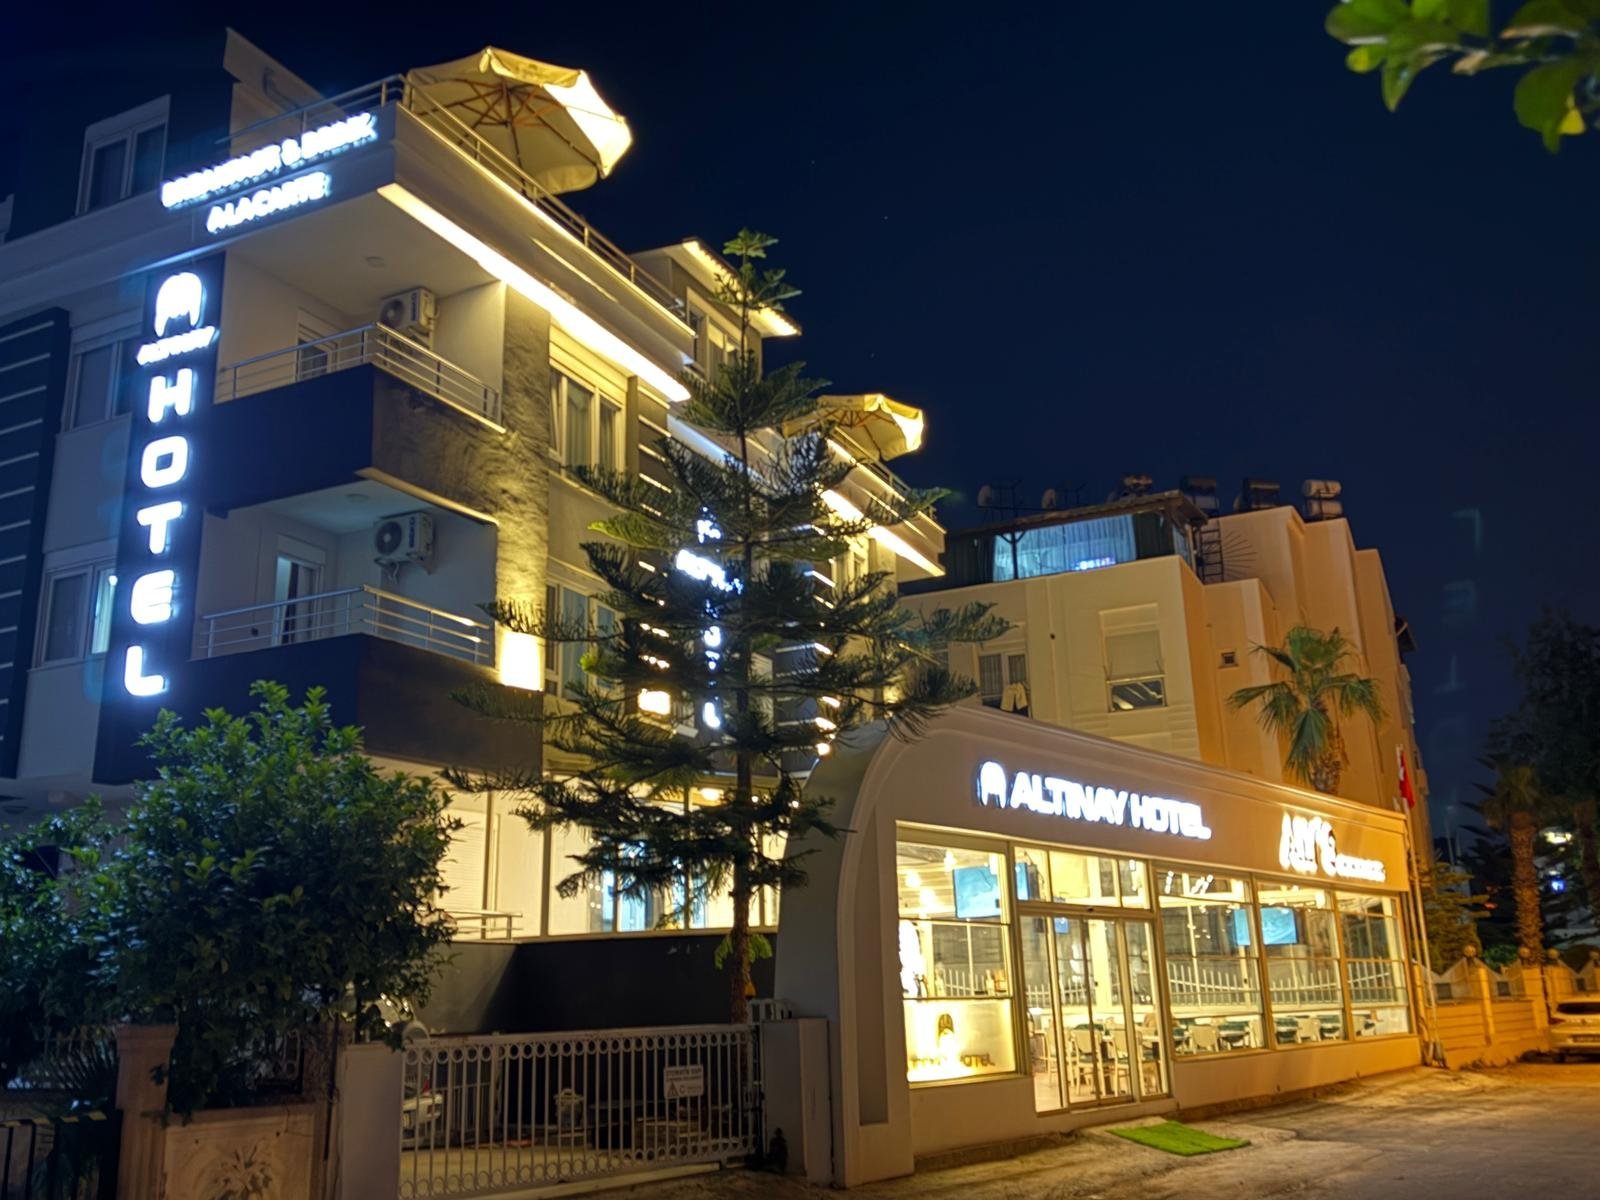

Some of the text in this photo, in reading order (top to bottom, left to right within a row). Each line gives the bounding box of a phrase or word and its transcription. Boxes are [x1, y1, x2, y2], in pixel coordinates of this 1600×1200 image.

[123, 367, 193, 697] HOTEL
[1010, 771, 1129, 826] ALTINAY
[1130, 792, 1212, 840] HOTEL
